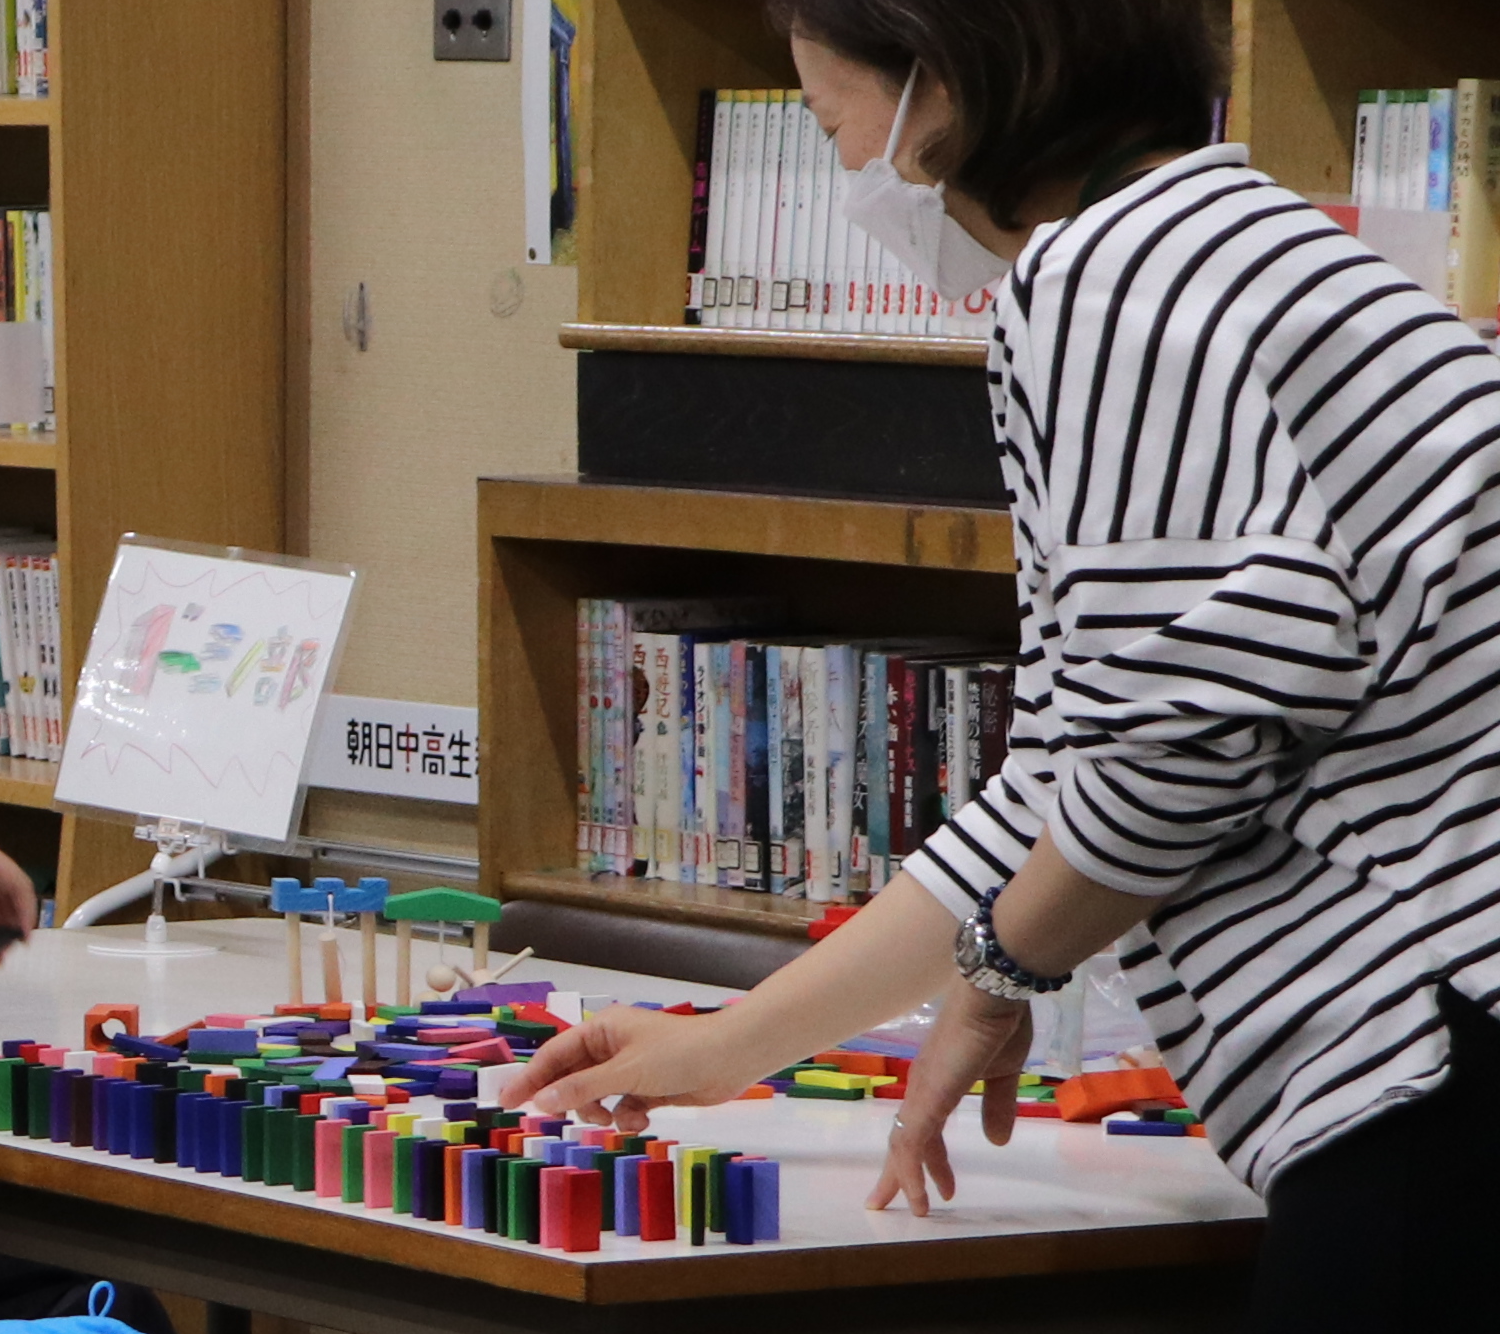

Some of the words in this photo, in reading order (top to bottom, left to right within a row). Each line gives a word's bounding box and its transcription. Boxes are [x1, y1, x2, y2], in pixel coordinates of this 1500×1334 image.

[654, 648, 671, 718] 西遊記
[347, 718, 478, 778] 朝日中高生
